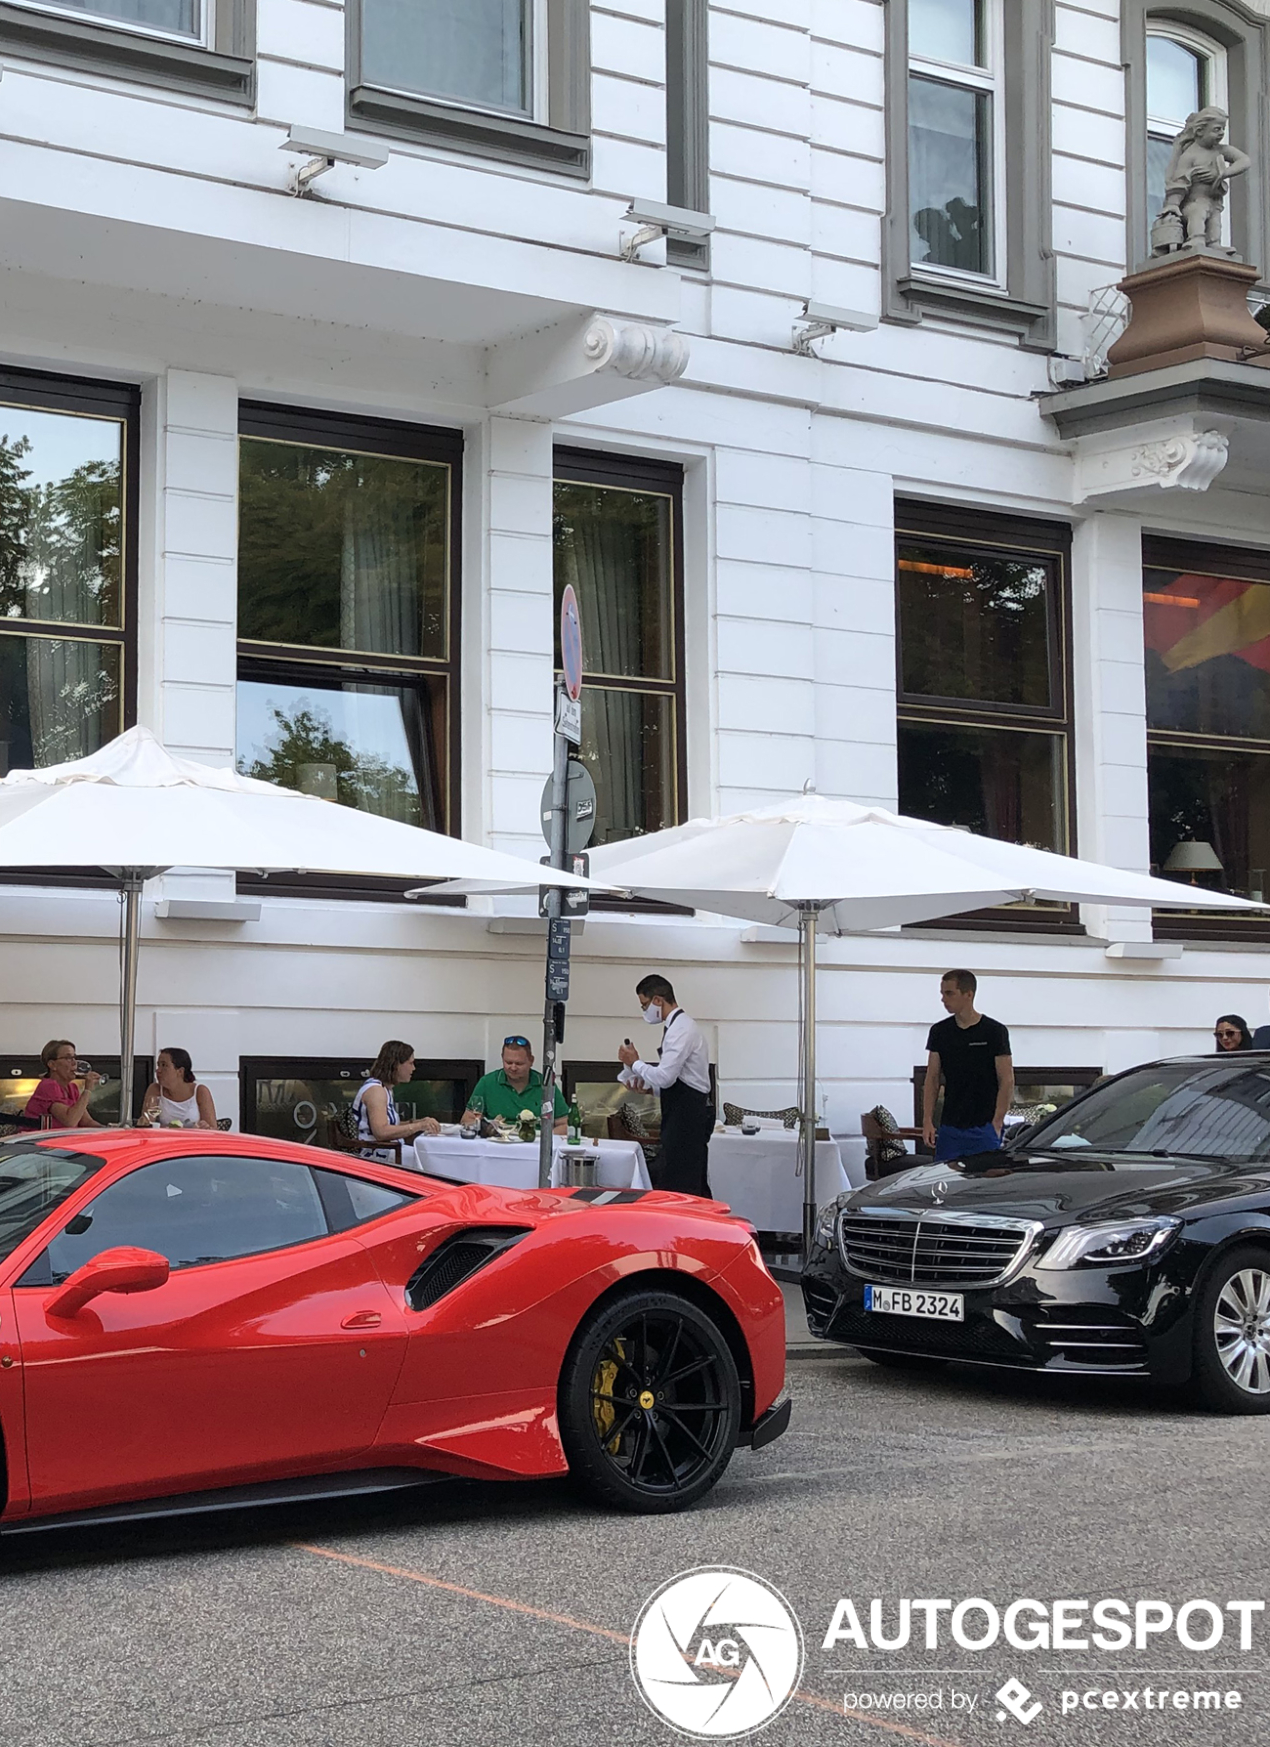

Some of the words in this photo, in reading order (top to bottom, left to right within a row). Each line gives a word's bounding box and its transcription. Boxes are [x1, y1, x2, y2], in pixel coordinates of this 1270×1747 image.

[873, 1289, 882, 1309] M
[891, 1292, 912, 1312] FB
[916, 1294, 960, 1317] 2324
